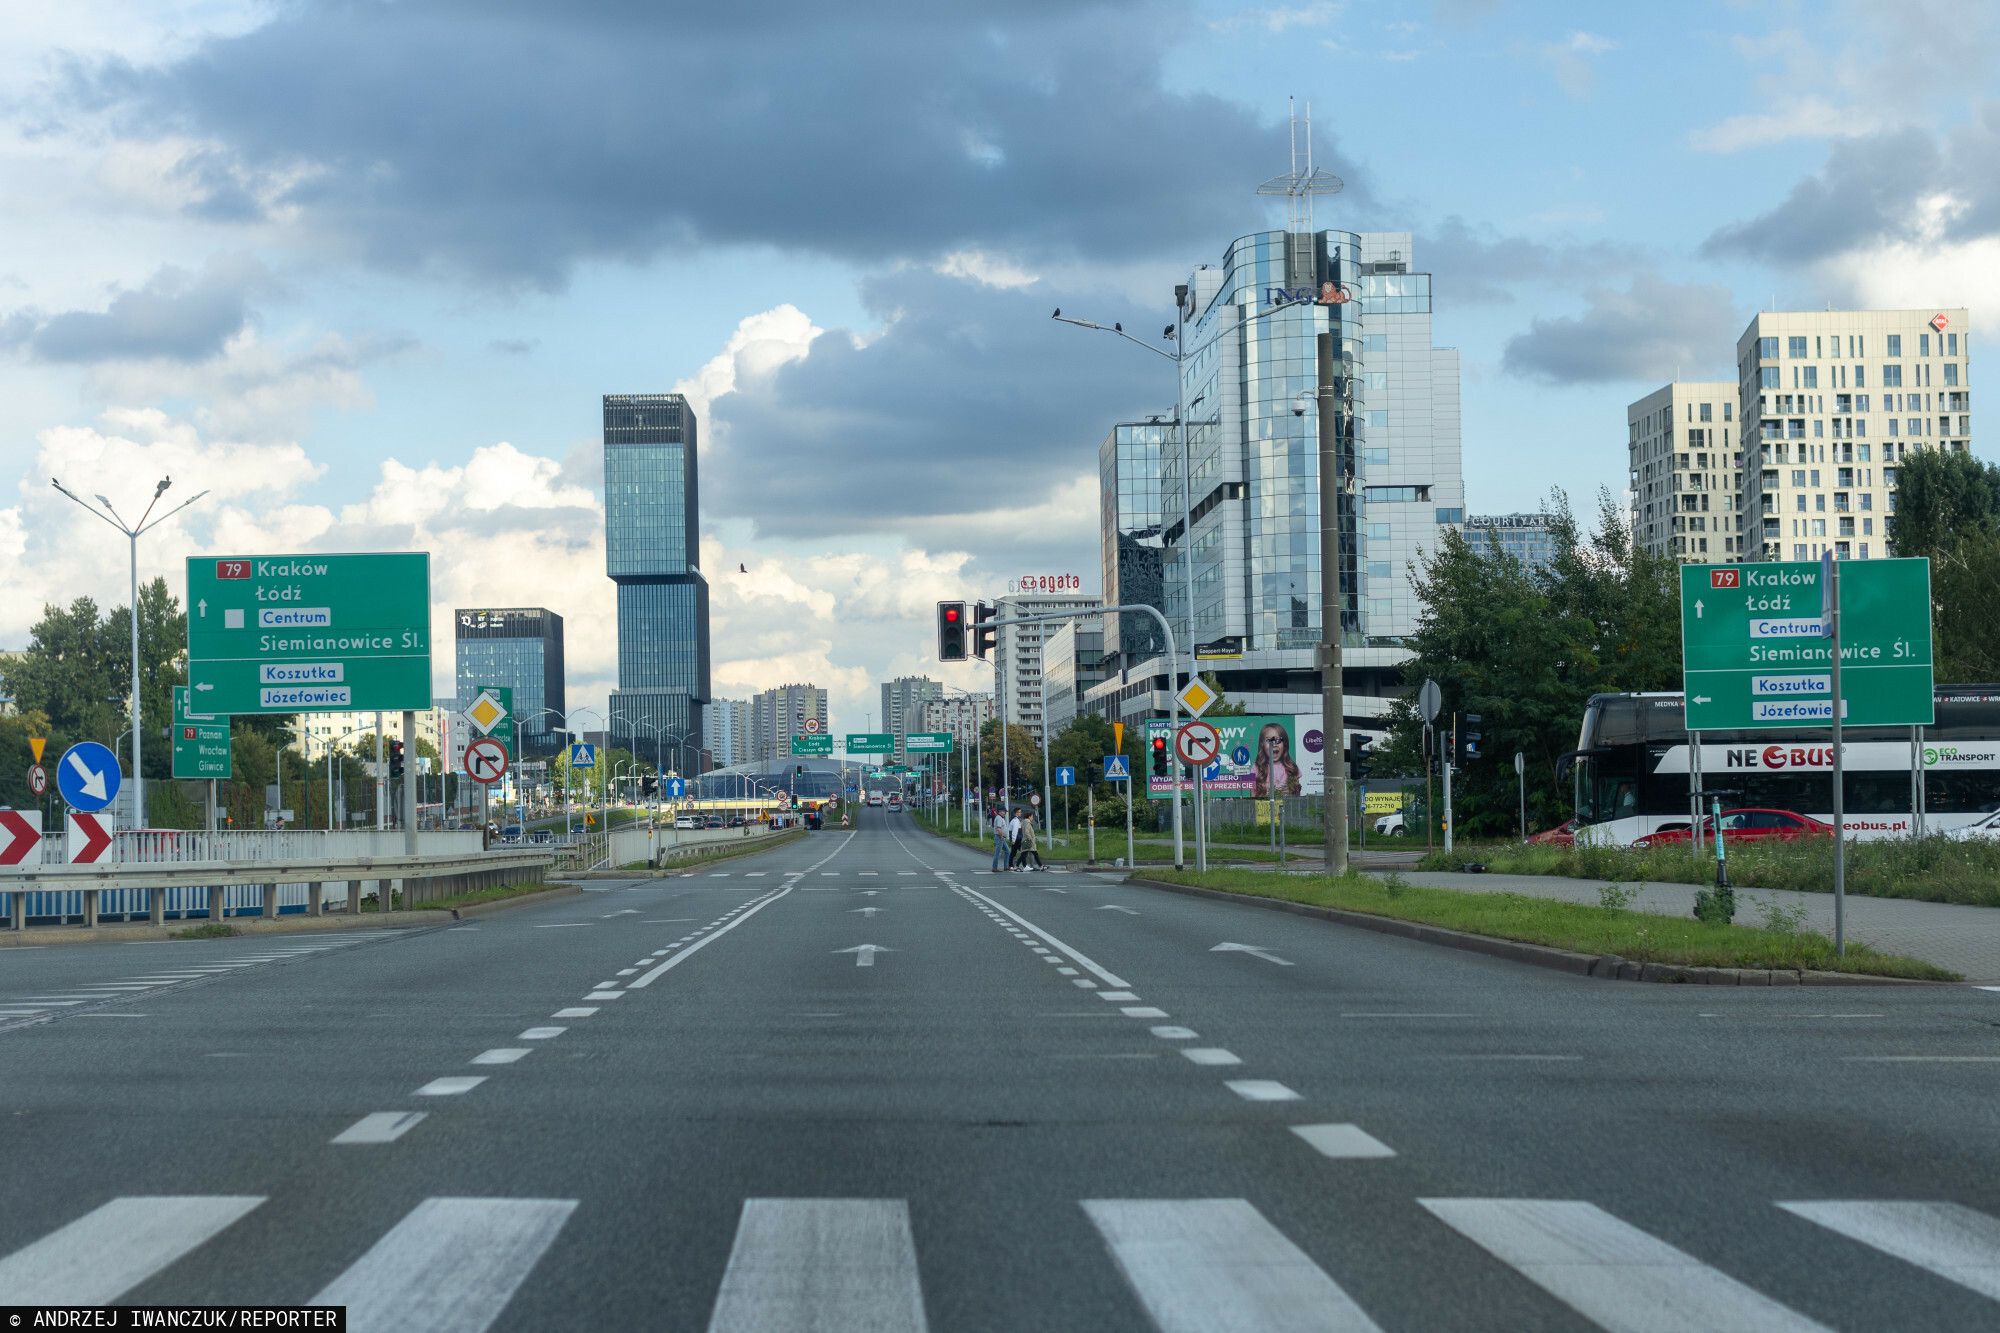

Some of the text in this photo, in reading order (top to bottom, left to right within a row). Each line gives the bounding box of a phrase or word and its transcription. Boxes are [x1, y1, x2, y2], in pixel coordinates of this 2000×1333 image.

[1263, 287, 1312, 305] ING
[225, 559, 328, 577] 79 Kraków
[1040, 573, 1079, 593] agata
[1715, 569, 1816, 587] 79 Kraków
[255, 584, 302, 601] Łódź
[1745, 594, 1791, 611] Łódź
[263, 611, 326, 624] Centrum
[1759, 621, 1821, 634] Centrum
[260, 628, 424, 651] Siemianowice Śl.
[1893, 637, 1916, 658] Śl.
[266, 666, 336, 680] Koszutka
[1759, 679, 1825, 692] Koszutka
[264, 690, 347, 704] Józefowiec
[1760, 703, 1832, 717] Józefowie
[186, 729, 194, 738] 79
[1218, 727, 1246, 738] AWY
[198, 744, 228, 755] Wrocław
[198, 760, 224, 772] Gliwice
[1151, 783, 1183, 791] ODBIEZ
[1842, 821, 1907, 832] eobus.pl
